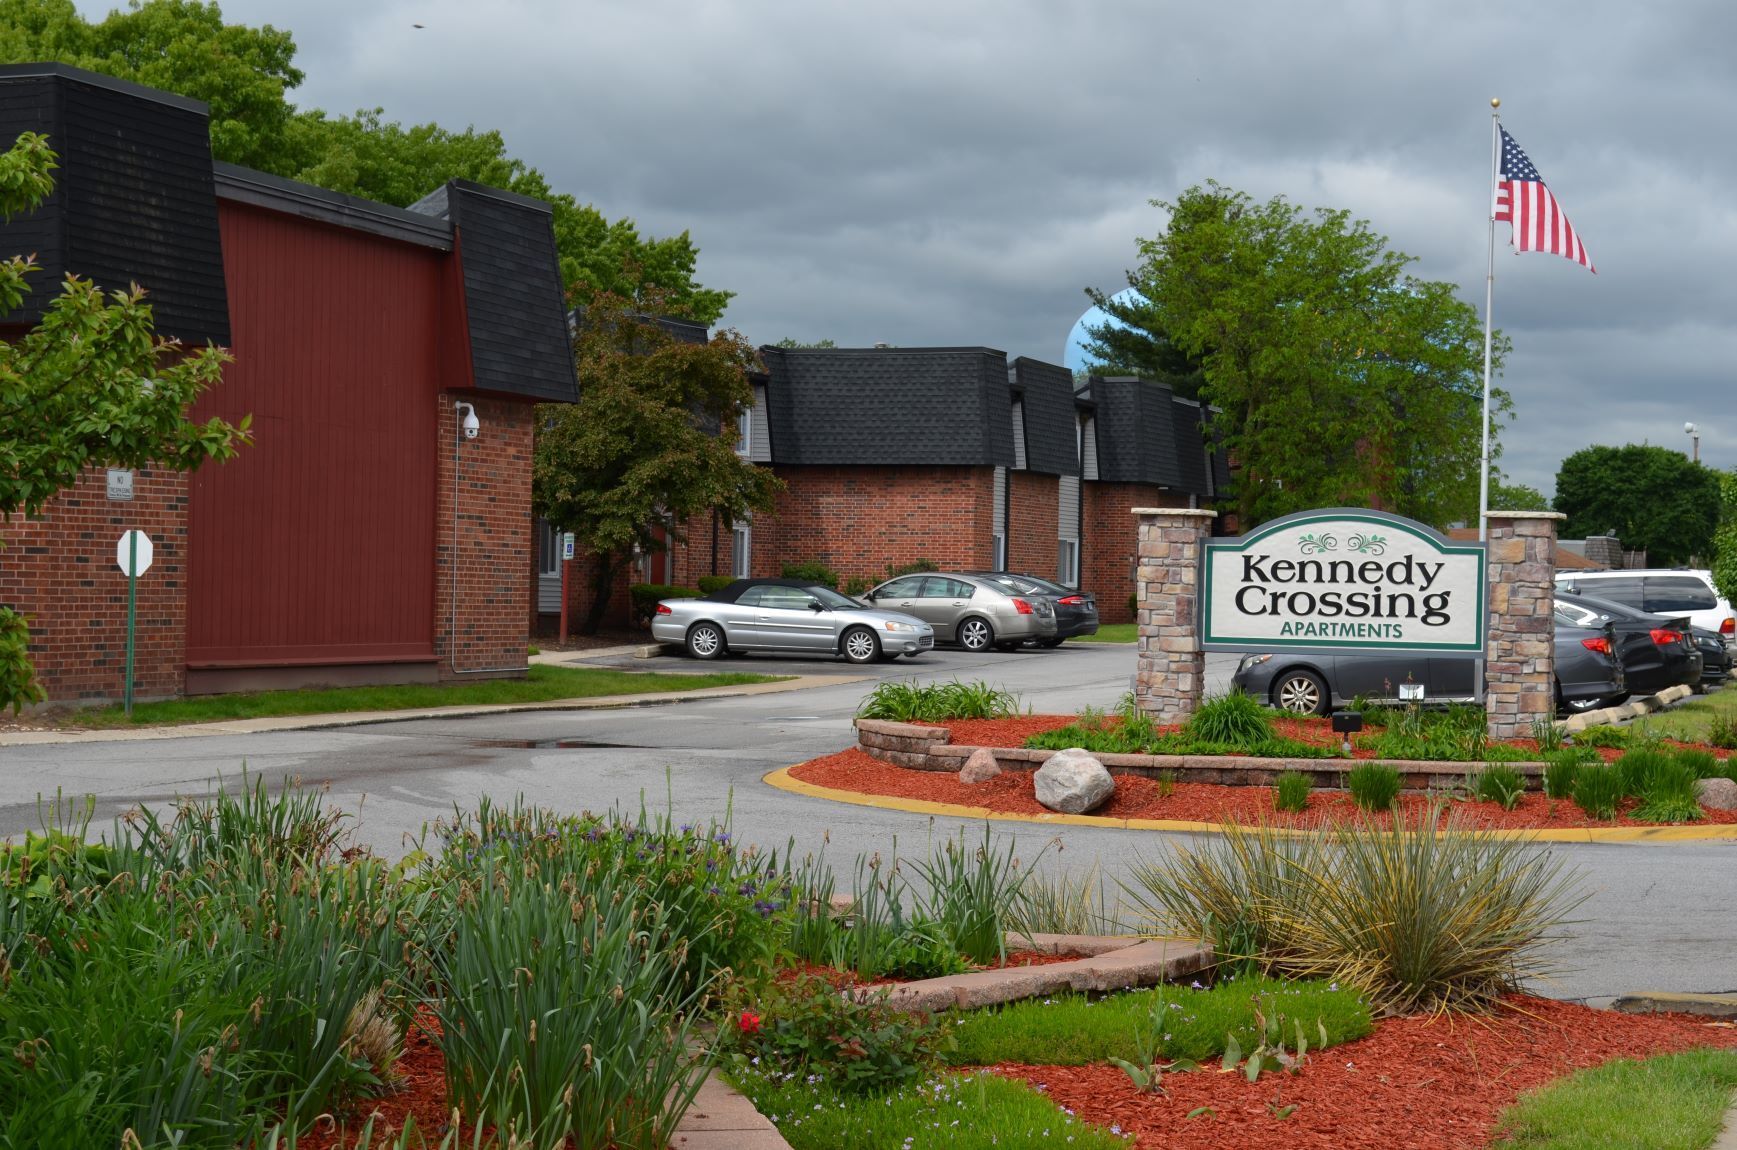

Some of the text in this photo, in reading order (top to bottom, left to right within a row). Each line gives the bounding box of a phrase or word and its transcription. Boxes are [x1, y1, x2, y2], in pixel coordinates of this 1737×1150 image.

[1241, 554, 1445, 591] Kennedy
[1235, 585, 1451, 626] Crossing
[1280, 621, 1403, 638] APARTMENTS
